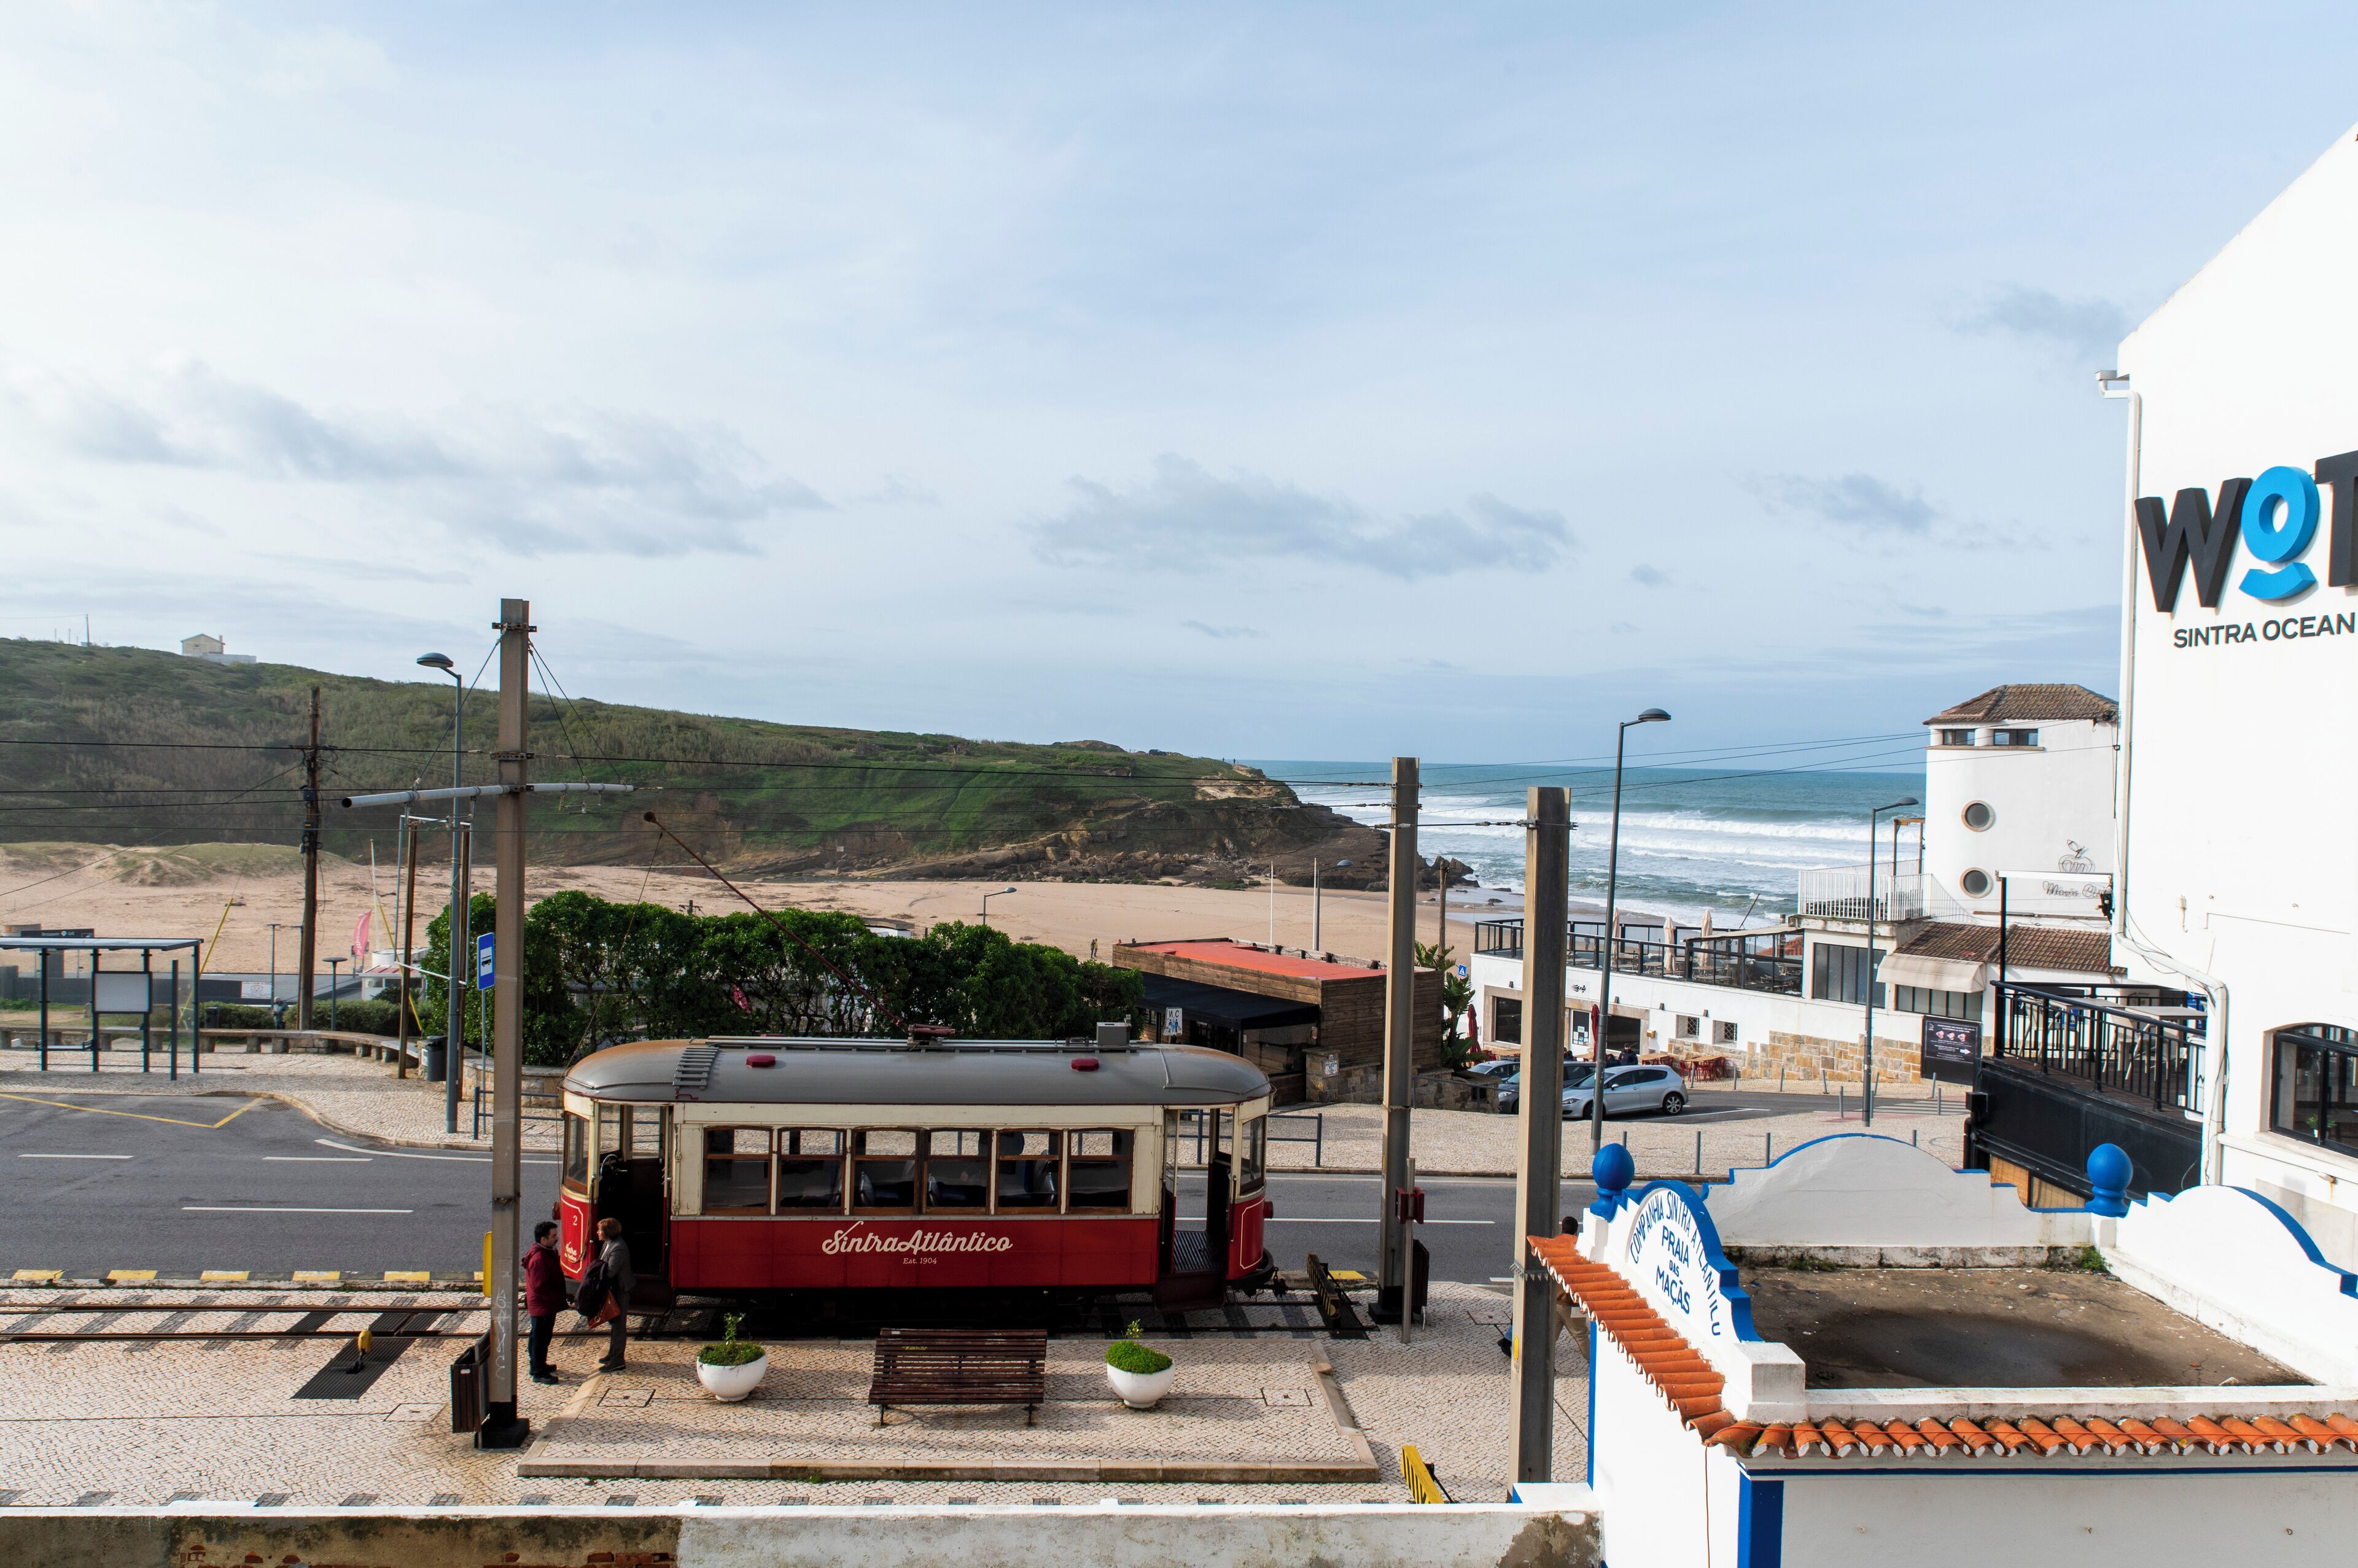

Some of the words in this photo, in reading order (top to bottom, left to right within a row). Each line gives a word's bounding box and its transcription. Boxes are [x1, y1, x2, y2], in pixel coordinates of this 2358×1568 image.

[2174, 622, 2257, 648] SINTRA
[2262, 612, 2355, 642] OCEAN
[572, 1214, 578, 1226] 2
[1630, 1195, 1664, 1264] COMPANHIA
[1666, 1190, 1692, 1237] SINTRA
[1662, 1225, 1689, 1268] PRAIA
[1669, 1259, 1679, 1278] DAS
[1656, 1265, 1691, 1315] MAÇÃS
